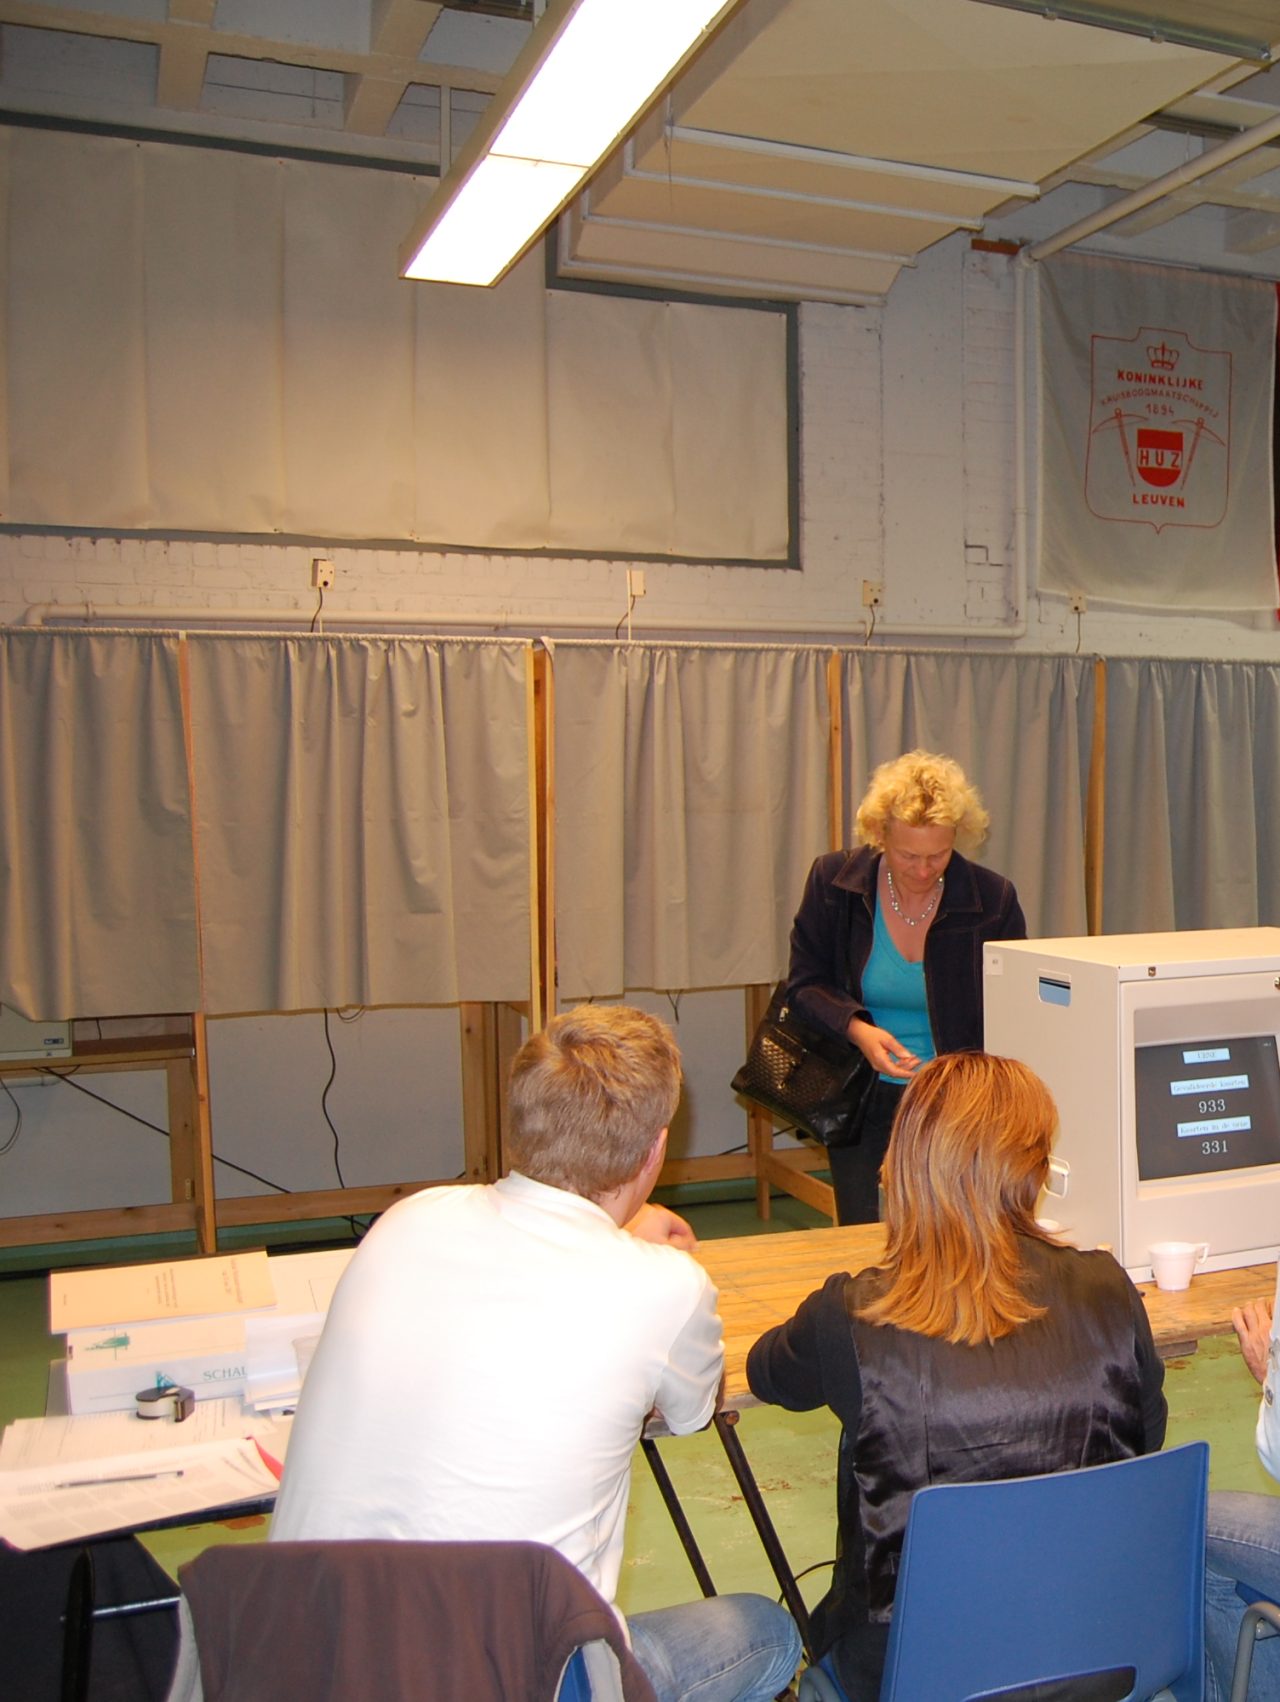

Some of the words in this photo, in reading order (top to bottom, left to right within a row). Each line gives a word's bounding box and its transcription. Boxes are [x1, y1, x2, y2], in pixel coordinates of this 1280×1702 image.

[1117, 369, 1204, 391] KONINKLIJKE
[1139, 450, 1181, 468] HUZ
[1132, 493, 1186, 509] LEUVEN
[1198, 1098, 1226, 1113] 933
[1201, 1139, 1228, 1155] 331
